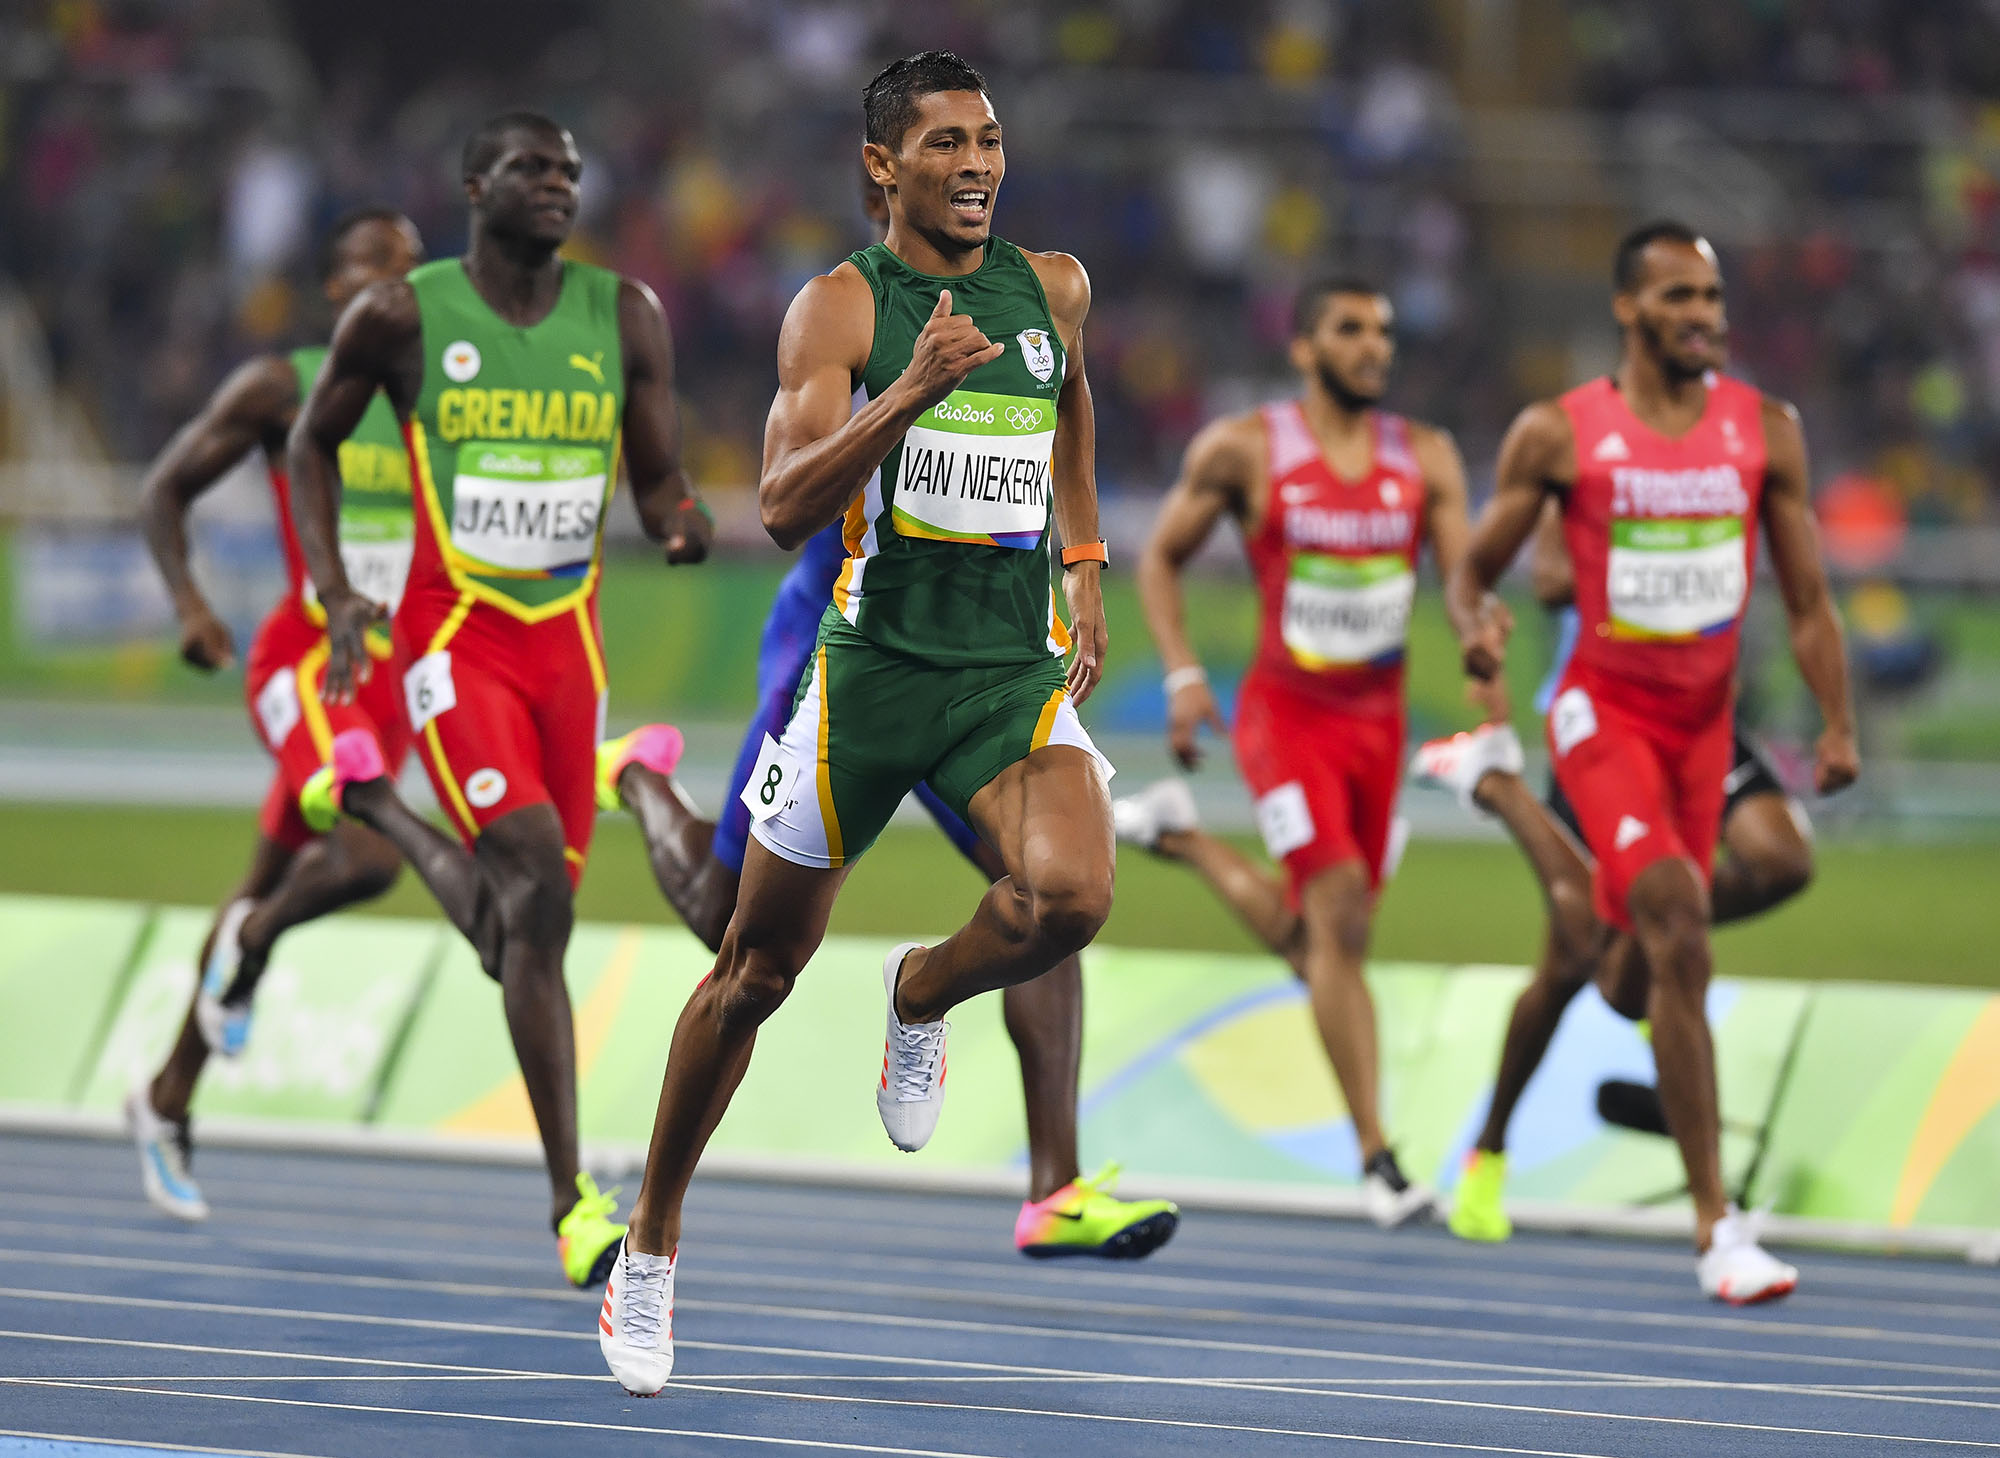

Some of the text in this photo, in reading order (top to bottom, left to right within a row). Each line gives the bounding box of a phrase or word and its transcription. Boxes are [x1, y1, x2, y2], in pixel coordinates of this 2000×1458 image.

[438, 388, 617, 442] GRENADA
[934, 401, 994, 425] Rio2016
[904, 446, 1047, 506] VAN NIEKERK
[457, 498, 597, 541] JAMES
[418, 675, 433, 711] 6
[761, 764, 782, 805] 8
